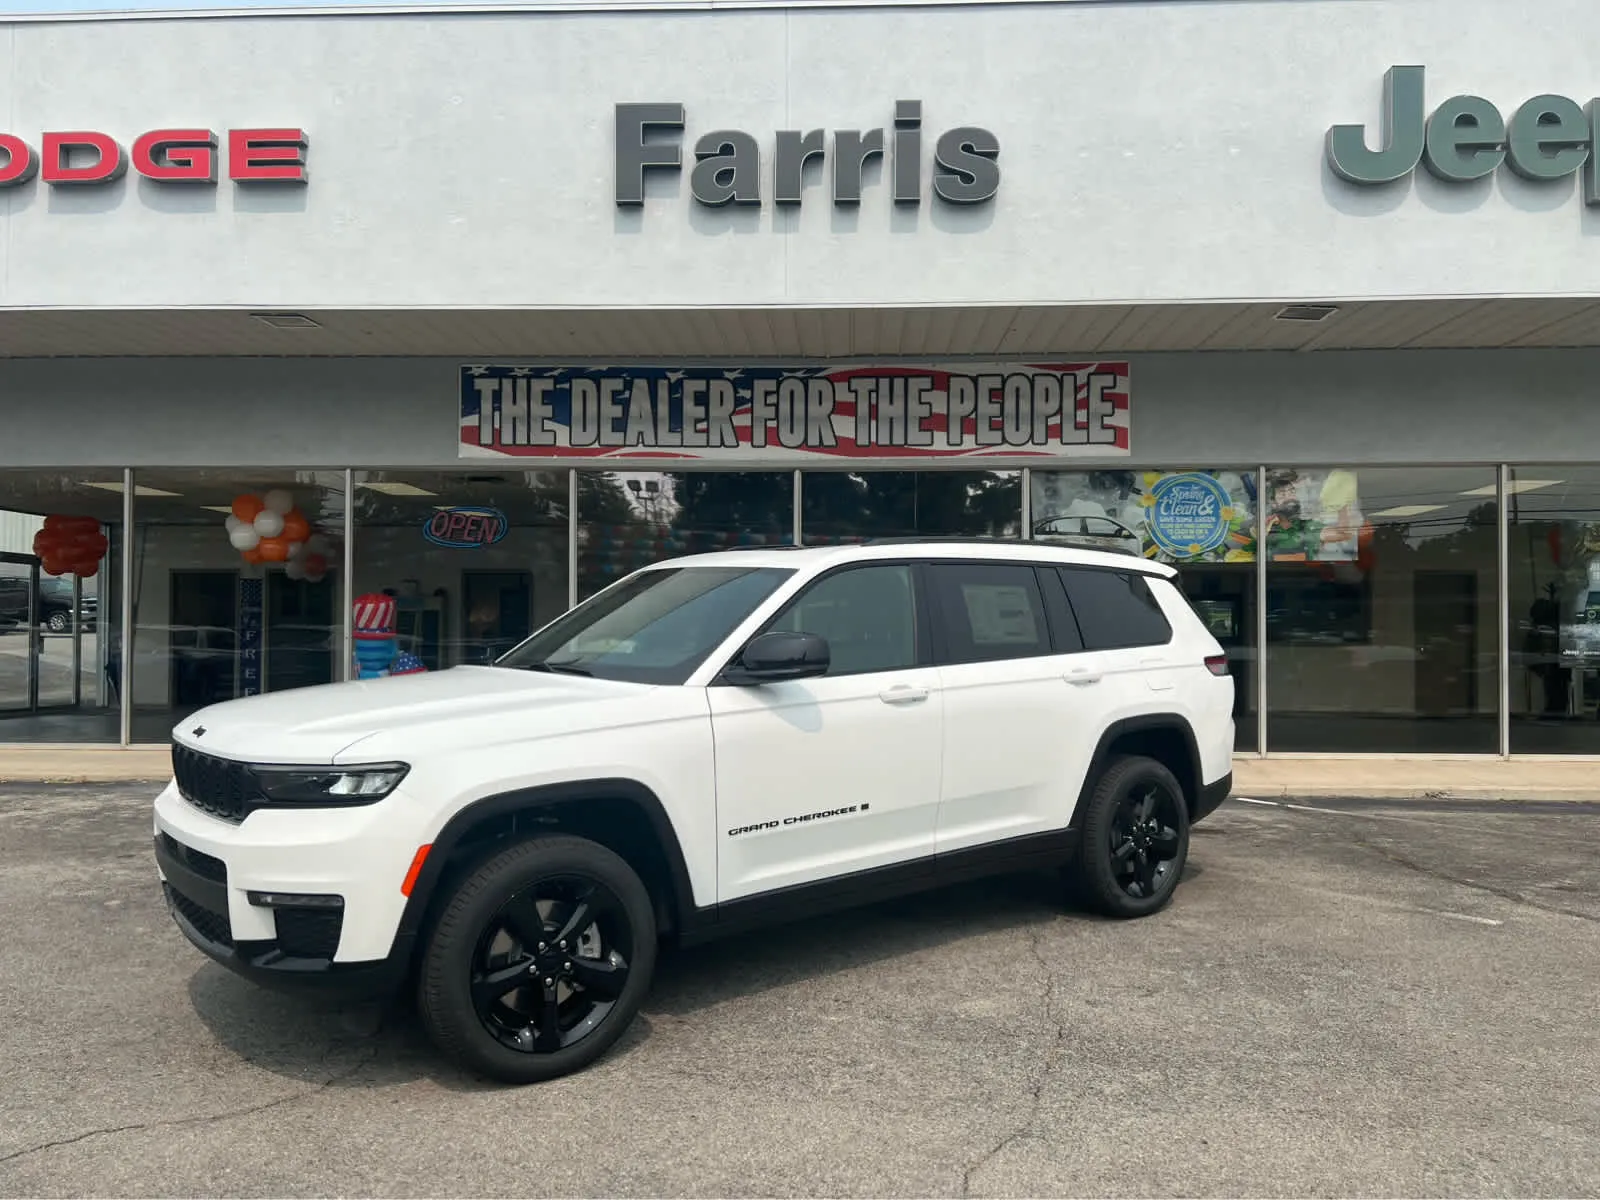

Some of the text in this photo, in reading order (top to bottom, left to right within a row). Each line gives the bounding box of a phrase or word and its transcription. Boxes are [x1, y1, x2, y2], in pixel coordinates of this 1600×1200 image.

[615, 100, 1001, 207] Farris
[1325, 65, 1600, 207] Jee
[473, 373, 1116, 448] THE DEALER FOR THE PEOPLE
[431, 511, 499, 544] OPEN
[1159, 495, 1215, 515] Clean &
[728, 805, 857, 836] GRAND CHEROKEE
